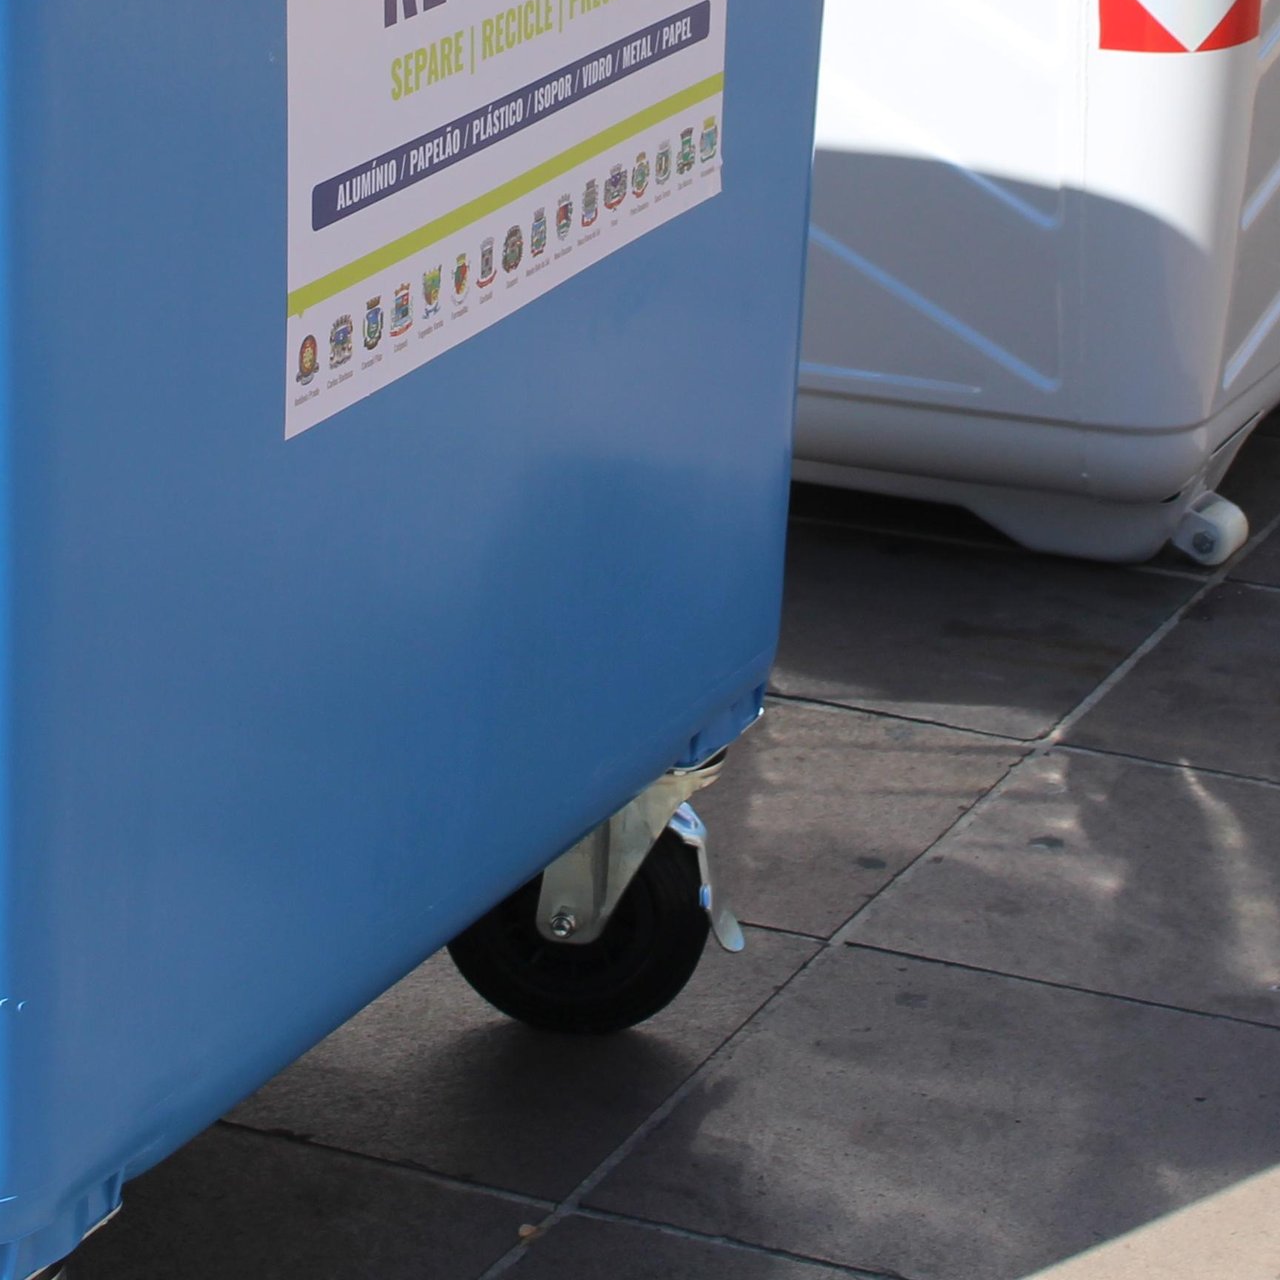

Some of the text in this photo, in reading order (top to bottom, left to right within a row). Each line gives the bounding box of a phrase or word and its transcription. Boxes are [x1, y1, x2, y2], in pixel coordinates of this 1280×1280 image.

[336, 160, 397, 211] ALUMÍNIO
[409, 127, 461, 176] PAPELÃO
[472, 97, 524, 145] PLÁSTICO
[534, 74, 572, 114] ISOPOR
[582, 53, 613, 88] VIDRO
[622, 34, 653, 69] METAL
[662, 16, 692, 49] PAPEL
[390, 30, 464, 101] SEPARE
